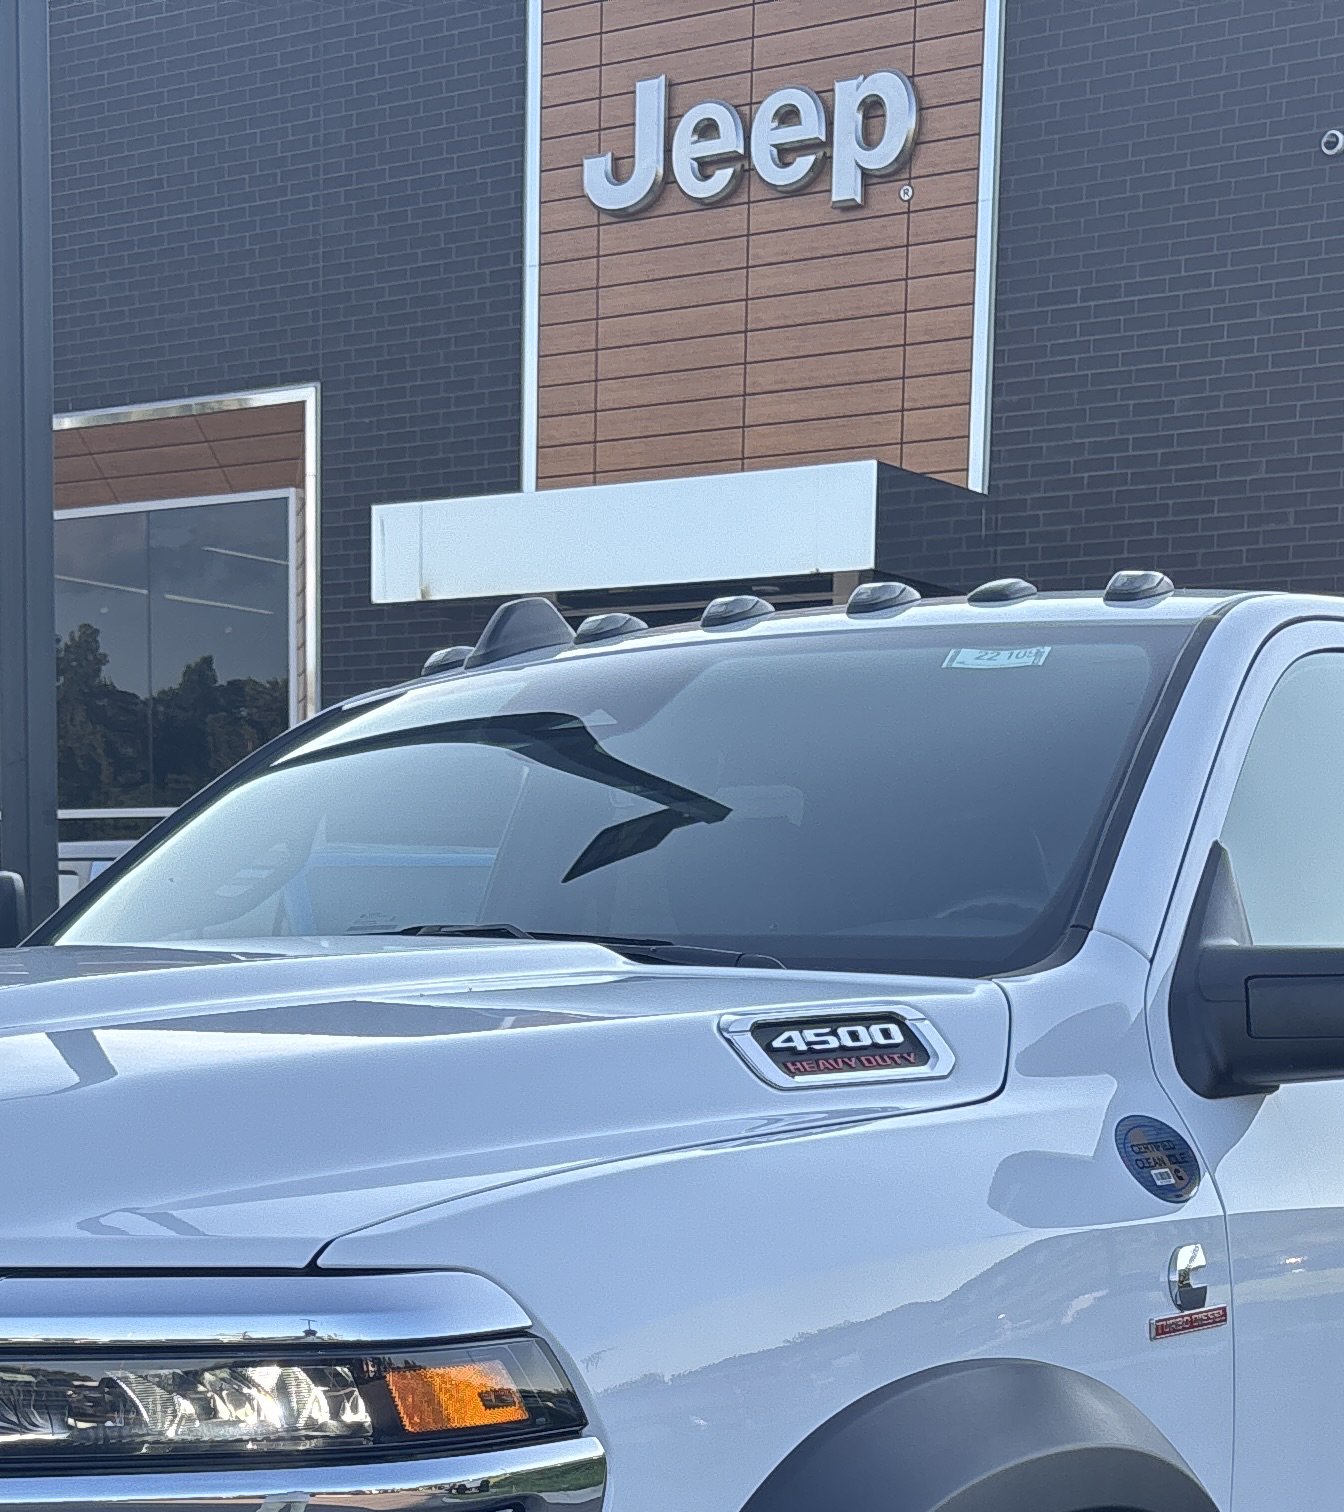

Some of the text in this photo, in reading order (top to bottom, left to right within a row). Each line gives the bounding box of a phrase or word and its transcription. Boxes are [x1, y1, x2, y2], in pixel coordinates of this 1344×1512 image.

[582, 66, 920, 218] Jeep
[771, 1023, 905, 1051] 4500
[785, 1052, 917, 1074] HEAVY DUTY
[1135, 1155, 1168, 1169] CLEAN
[1155, 1316, 1191, 1335] TURBO
